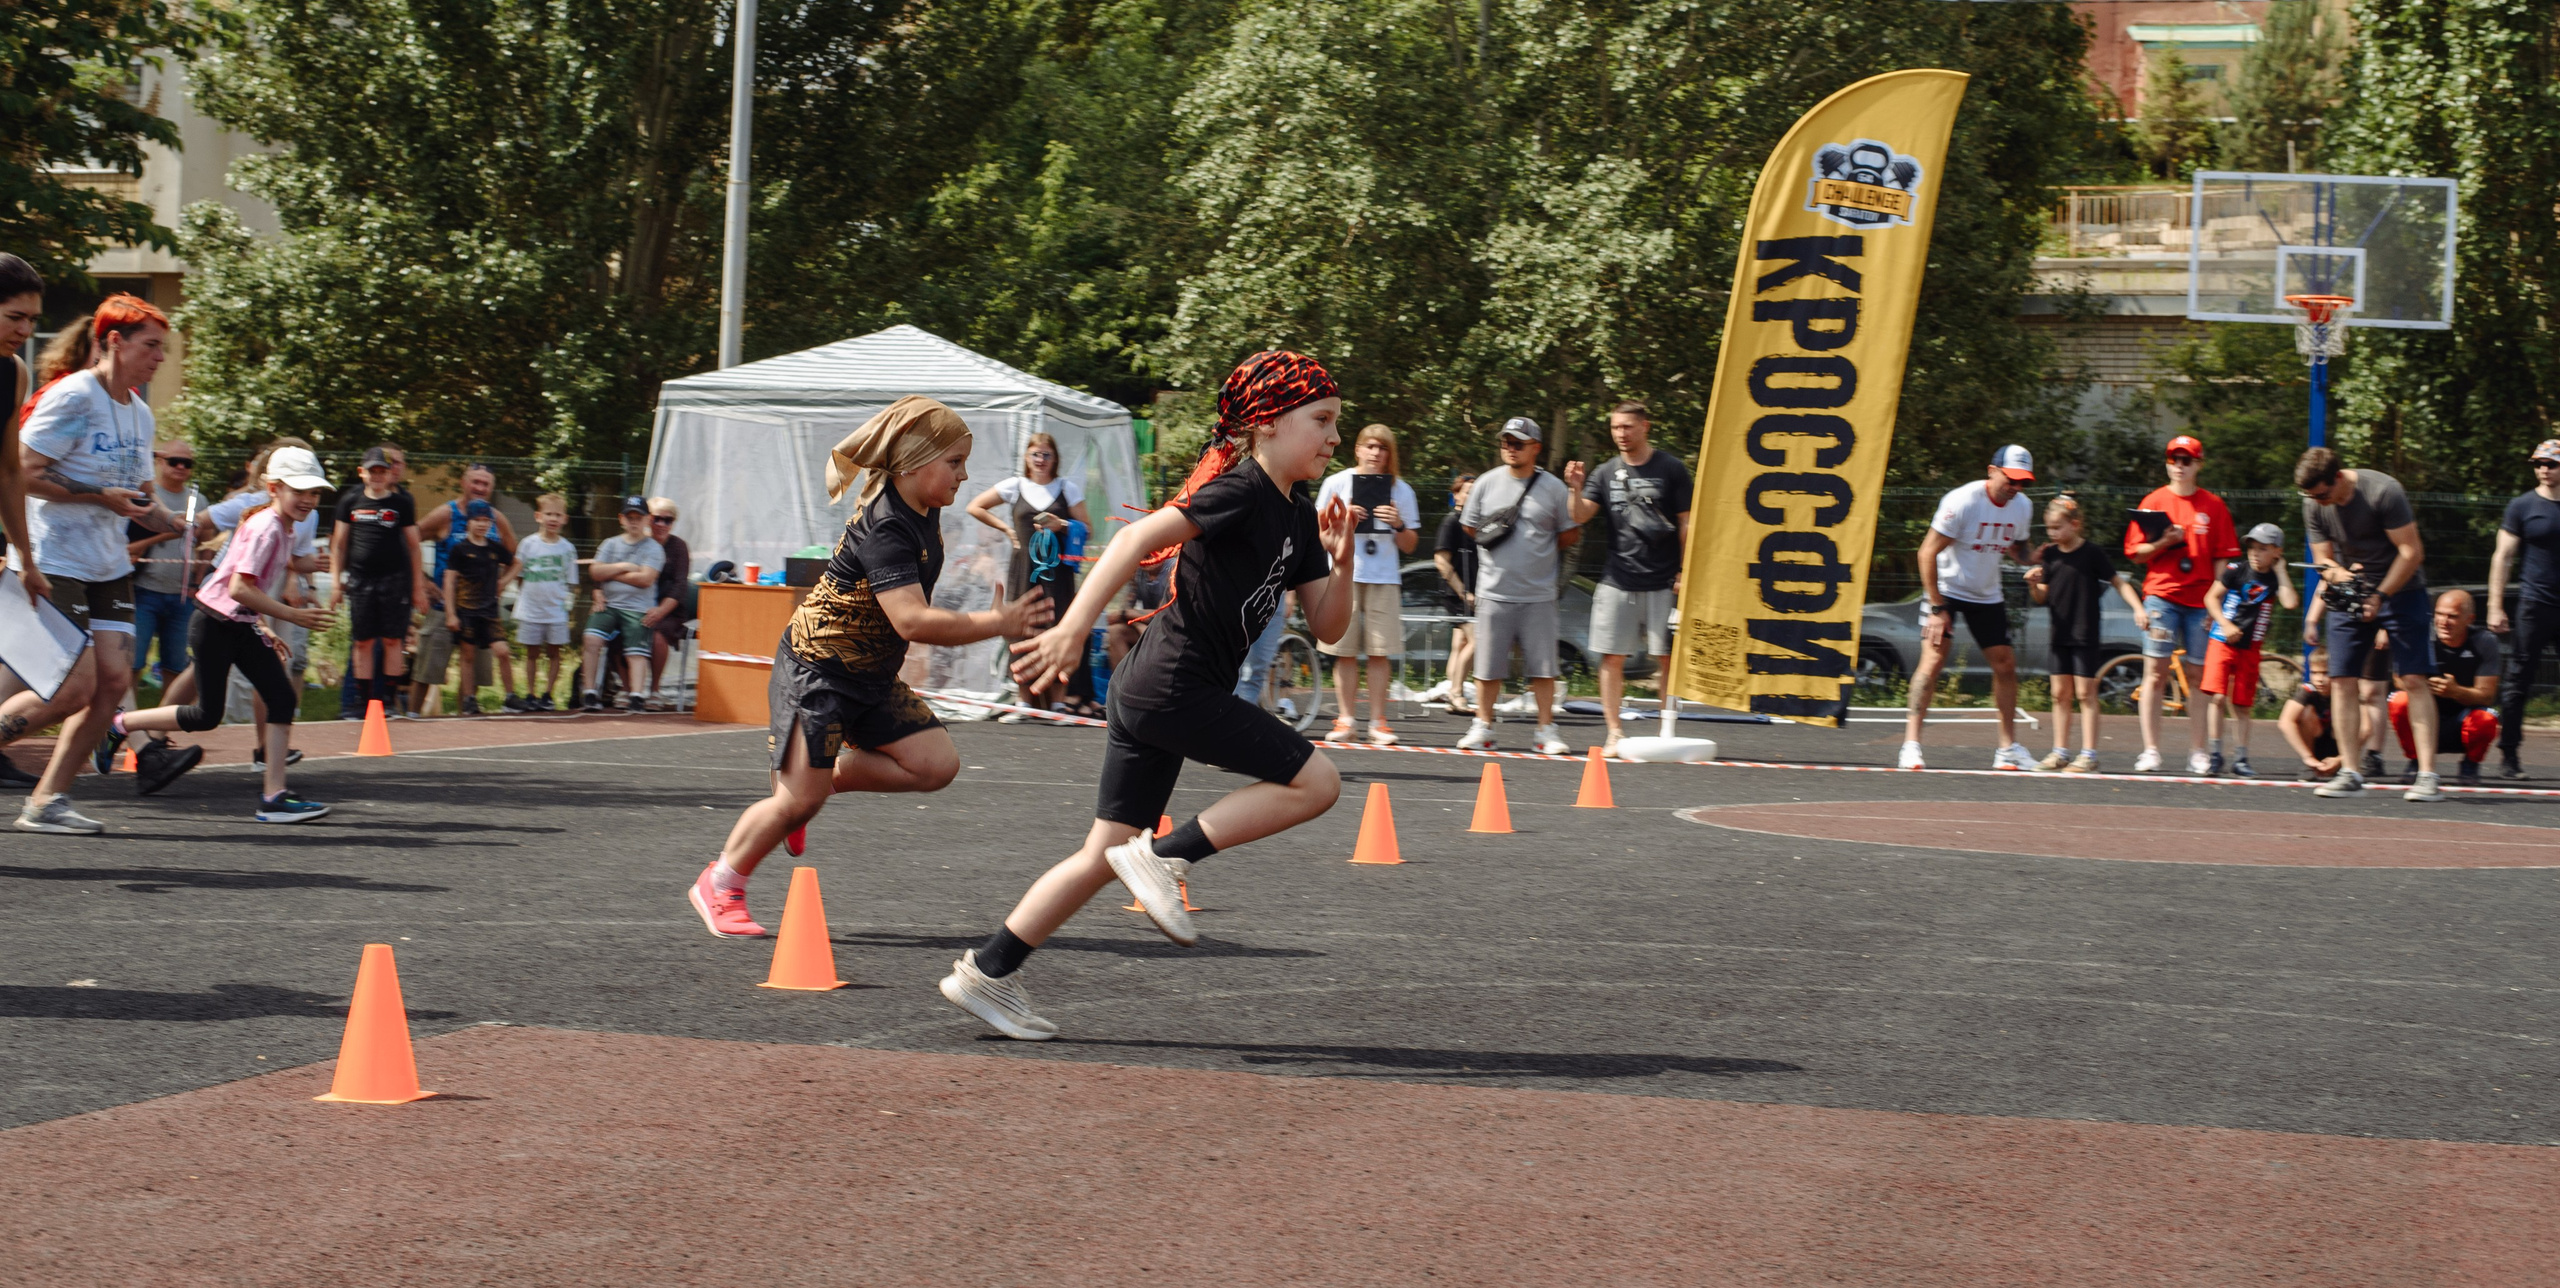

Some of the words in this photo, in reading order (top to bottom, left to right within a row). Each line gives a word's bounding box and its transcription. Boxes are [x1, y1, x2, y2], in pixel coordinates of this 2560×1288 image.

[1824, 183, 1902, 210] CHALLENGE
[1746, 235, 1863, 728] КРОССФИТ
[1975, 522, 2015, 541] ГТО
